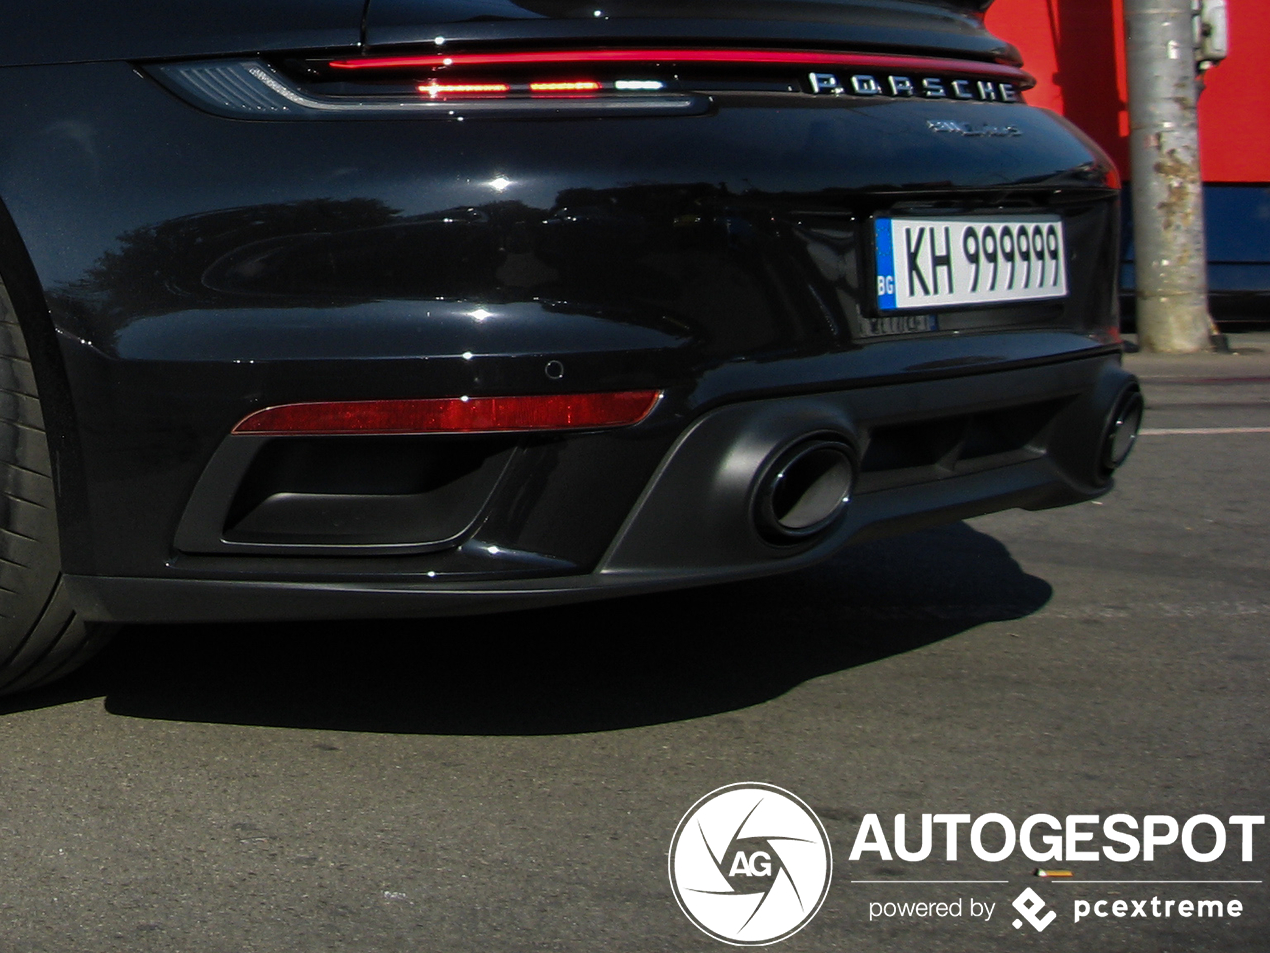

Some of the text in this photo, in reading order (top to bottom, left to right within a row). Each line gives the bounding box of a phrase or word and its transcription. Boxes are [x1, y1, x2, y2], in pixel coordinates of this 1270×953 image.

[809, 72, 1017, 102] PORSCHE
[905, 224, 1059, 297] KH 999999
[877, 275, 895, 296] BG
